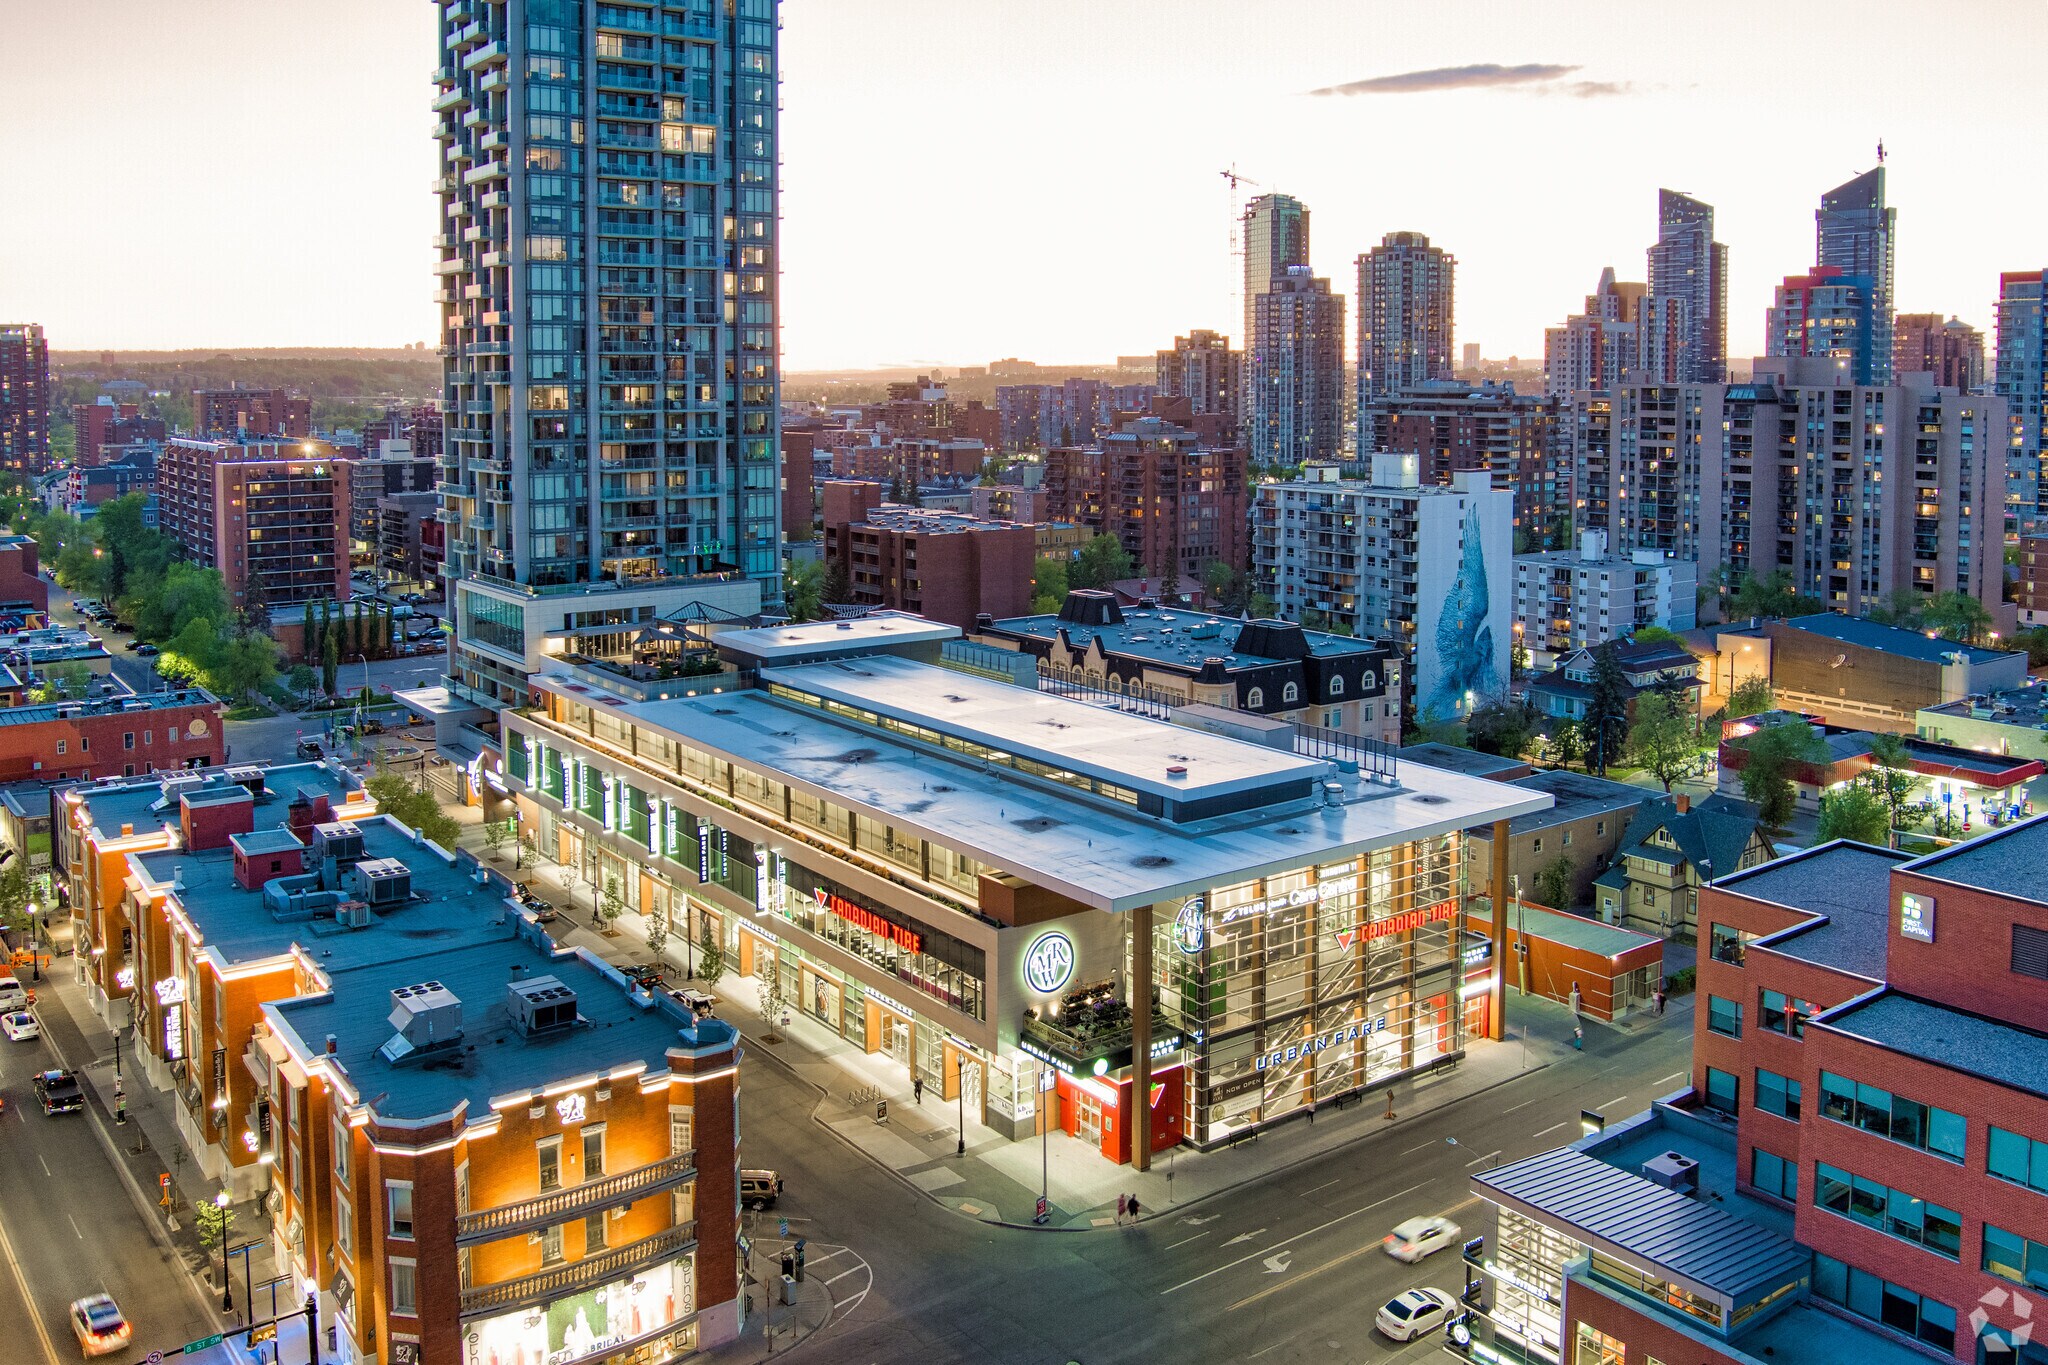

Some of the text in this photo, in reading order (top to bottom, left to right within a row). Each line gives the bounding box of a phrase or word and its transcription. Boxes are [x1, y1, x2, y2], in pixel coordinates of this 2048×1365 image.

[829, 893, 922, 956] CANADIAN TIRE
[1360, 900, 1459, 943] CANADIAN TIRE
[1902, 917, 1923, 928] FIRST
[1902, 924, 1931, 937] CAPITAL
[1151, 1036, 1180, 1051] RBAN
[1256, 1016, 1386, 1072] URBAN FARE
[1021, 1041, 1074, 1074] URBAN FARE
[1226, 1078, 1261, 1095] NOW OPEN
[1515, 1276, 1549, 1300] FITNESS
[590, 1334, 626, 1352] BRIDAL
